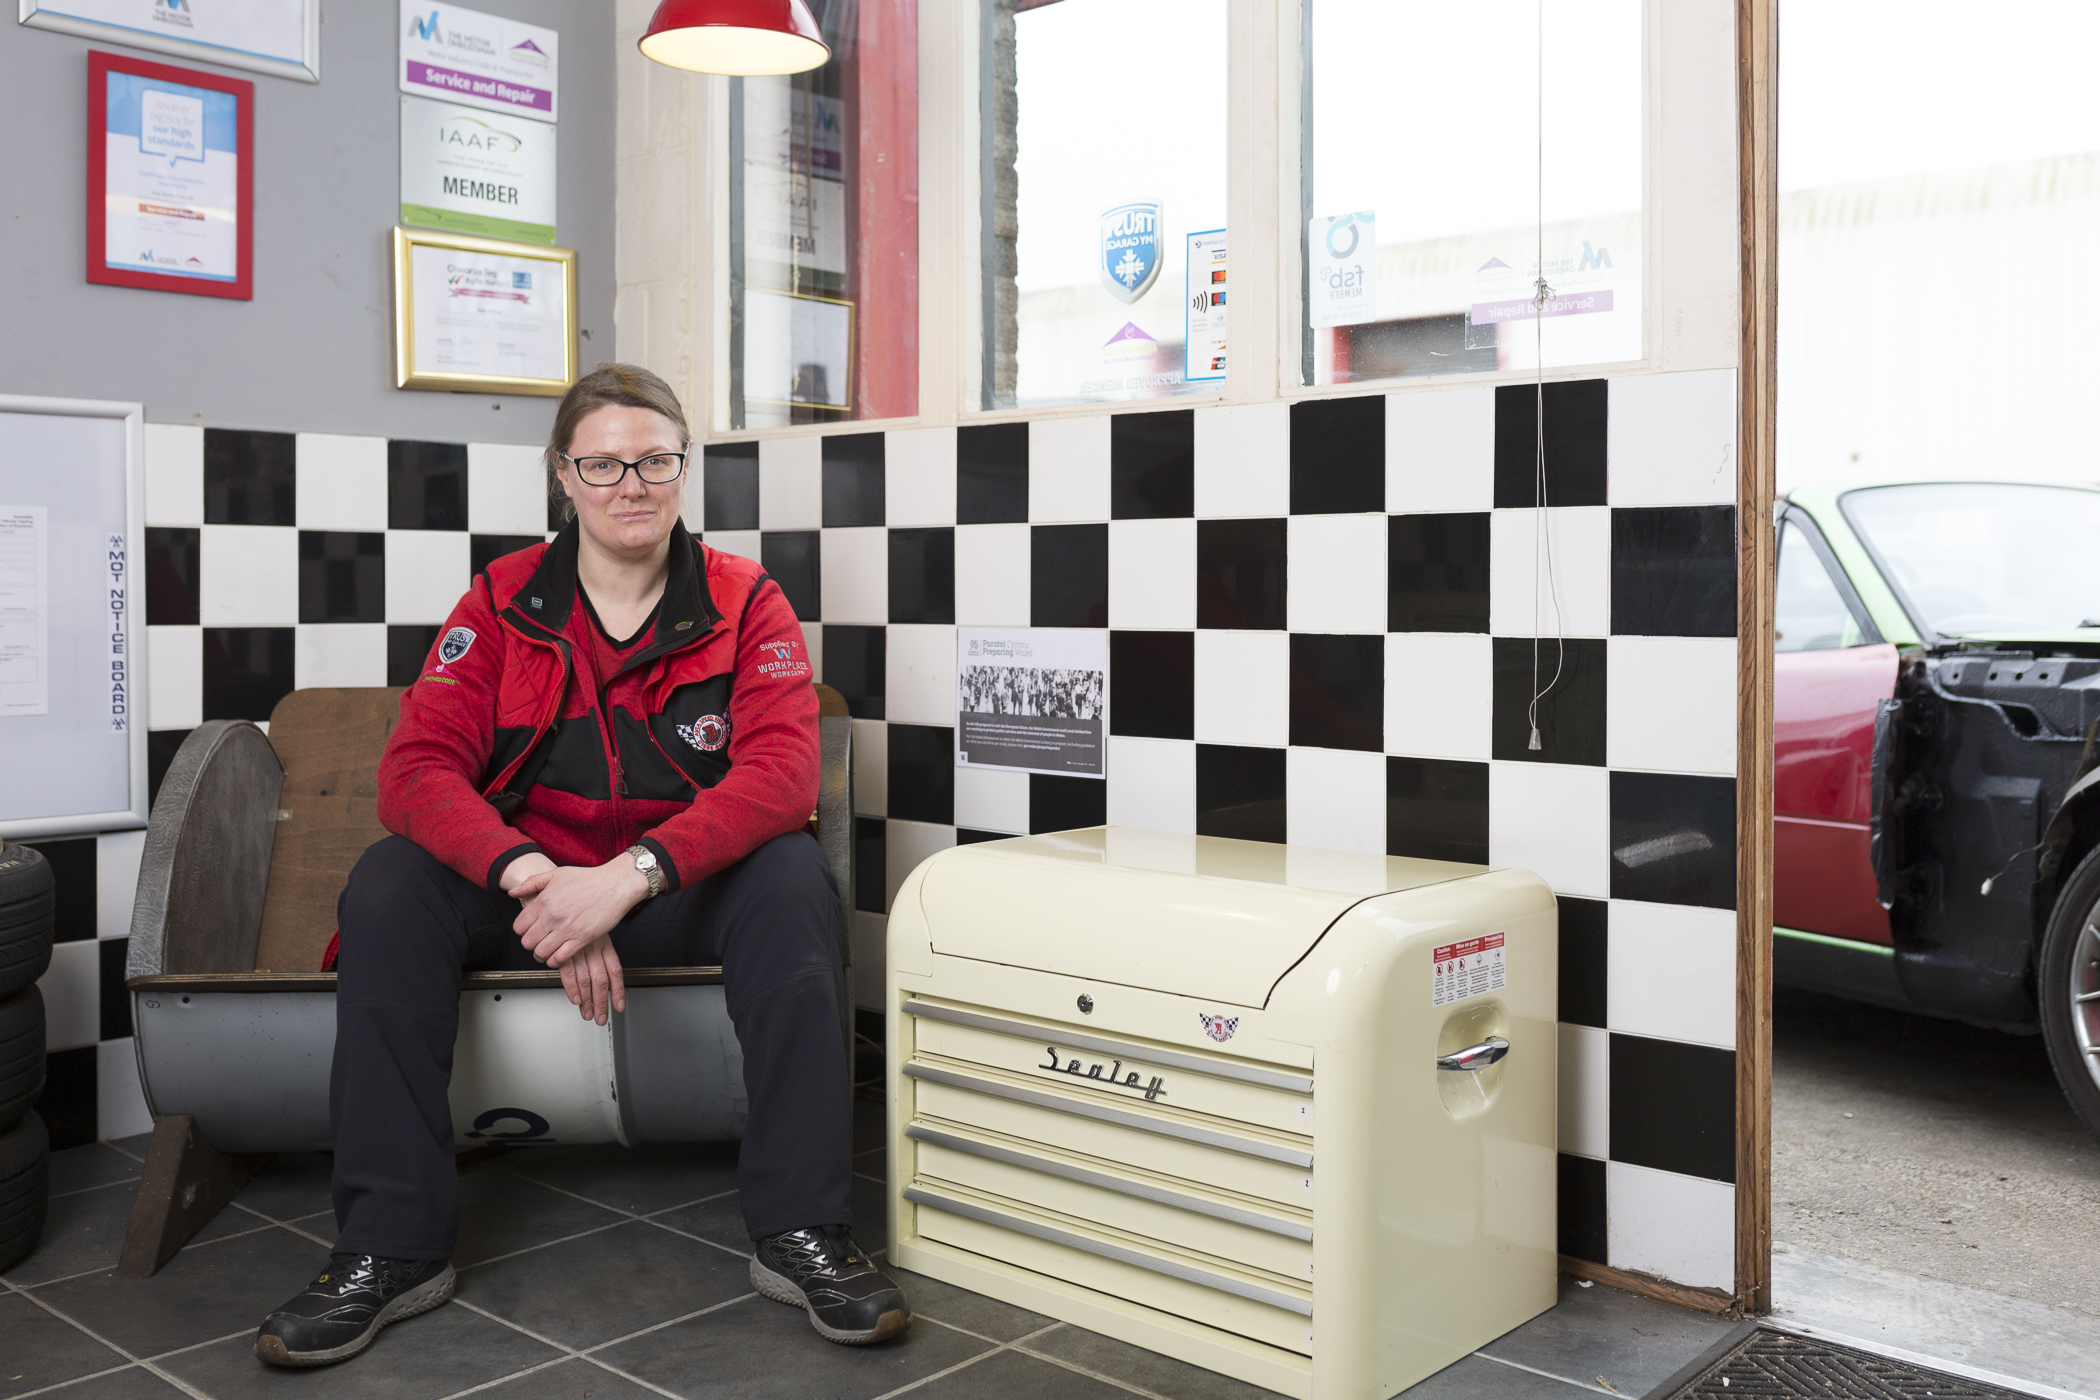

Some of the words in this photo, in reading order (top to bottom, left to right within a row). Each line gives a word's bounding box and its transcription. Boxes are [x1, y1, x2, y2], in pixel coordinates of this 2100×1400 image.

[446, 38, 496, 56] OMBUDSMAN
[448, 31, 462, 40] THE
[464, 34, 491, 47] MOTOR
[426, 68, 472, 91] Service
[472, 79, 496, 96] and
[497, 84, 536, 104] Repair
[155, 100, 190, 114] Another
[150, 111, 165, 125] big
[166, 113, 180, 124] tick
[182, 115, 194, 126] for
[152, 124, 169, 134] our
[171, 125, 192, 140] high
[440, 127, 499, 151] IAAF
[443, 176, 518, 205] MEMBER
[109, 551, 124, 582] MOT
[110, 589, 124, 654] NOTICE
[448, 632, 469, 642] TRUS
[1007, 640, 1029, 649] Cymru
[760, 640, 789, 651] Supplied
[982, 648, 1014, 657] Preparing
[757, 661, 808, 674] WORKPLACE
[112, 661, 125, 714] BOARD
[1038, 1046, 1168, 1101] Sealey
